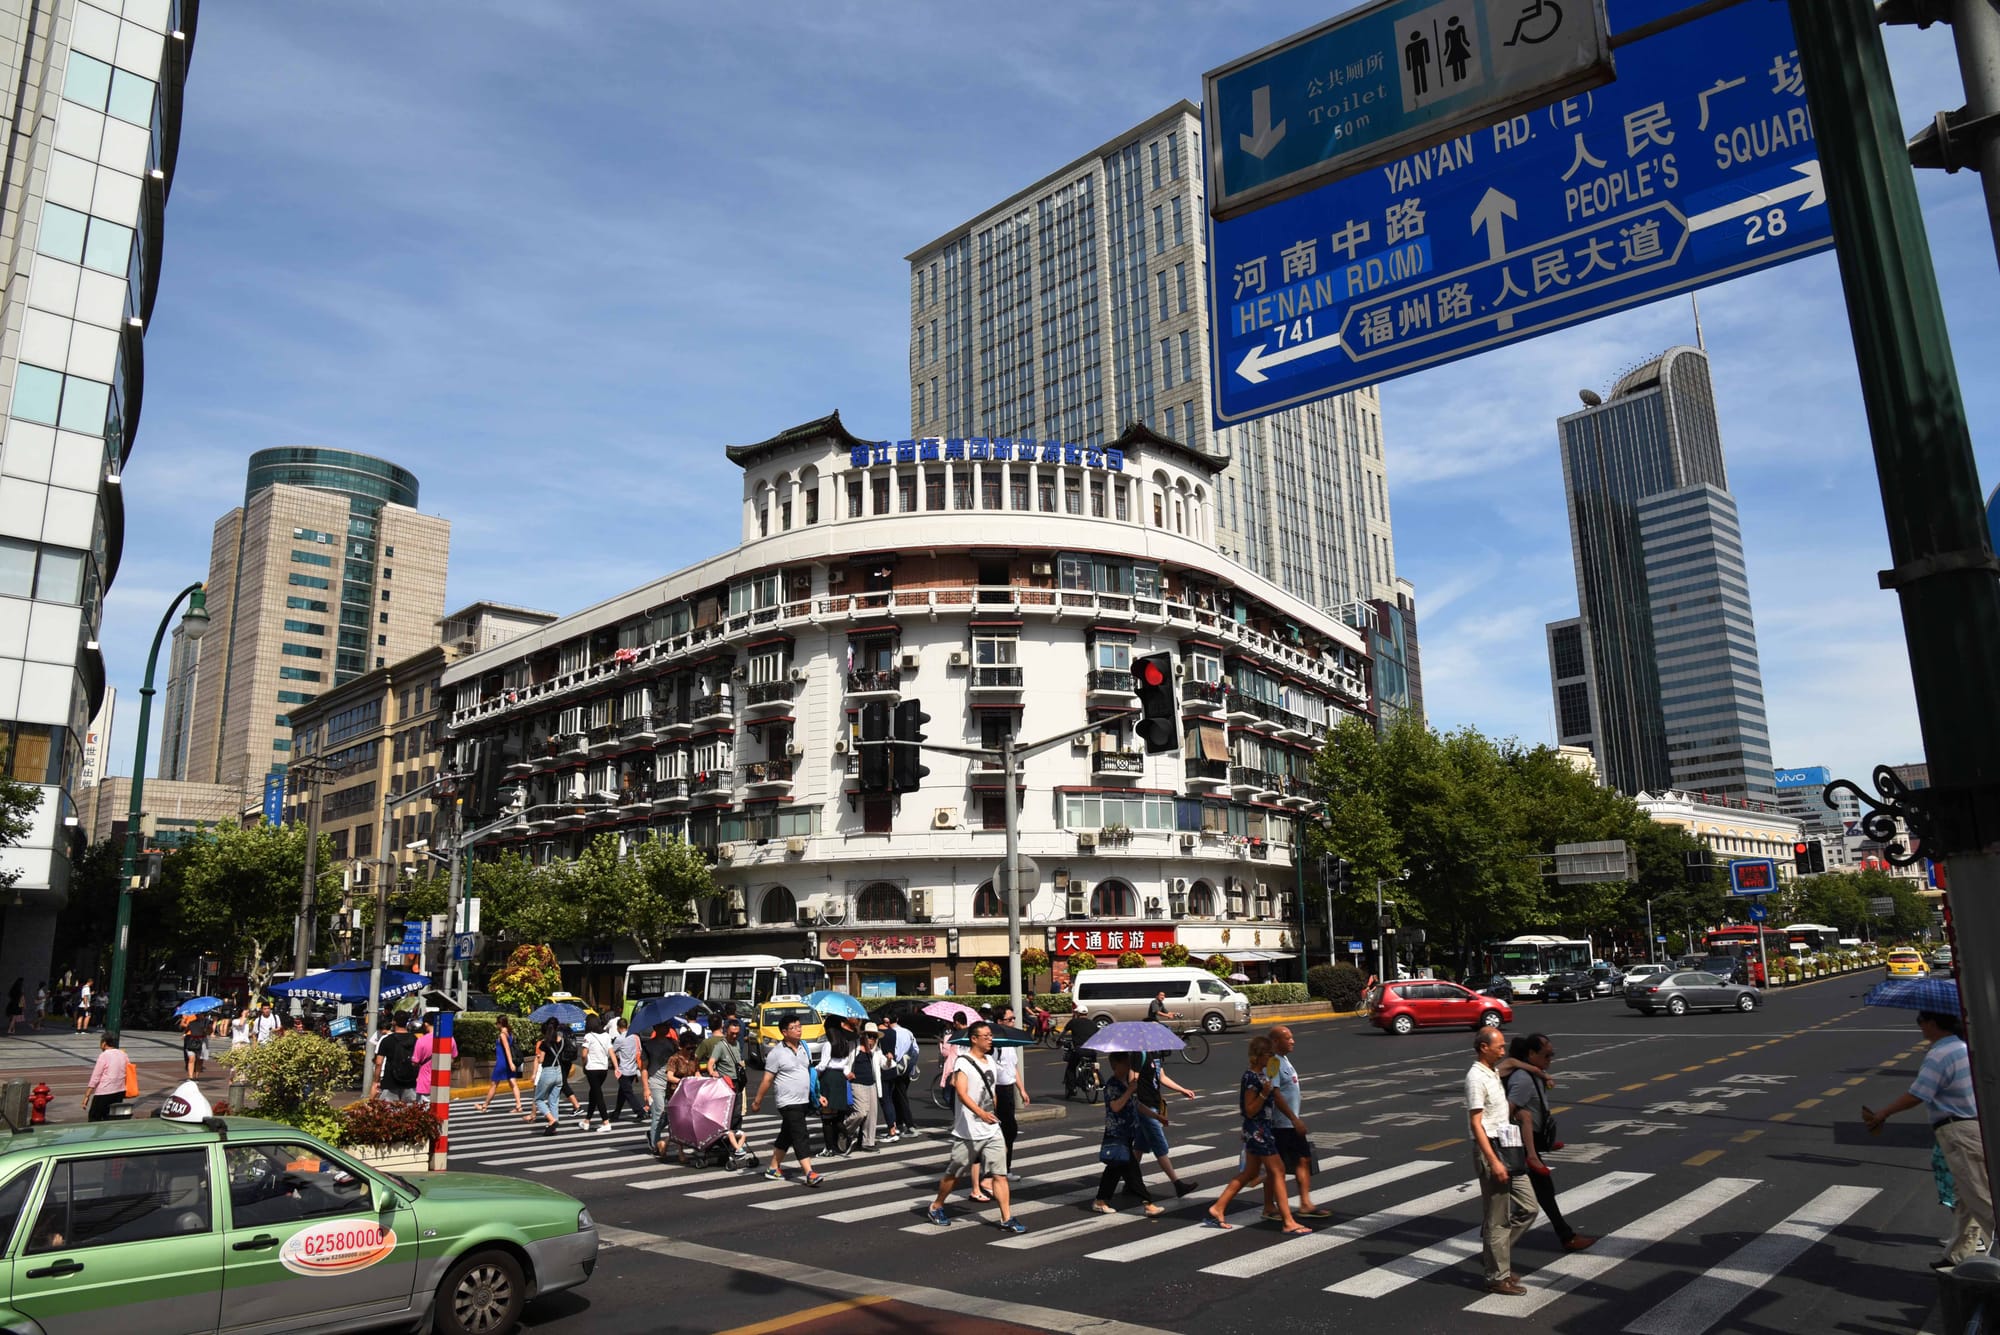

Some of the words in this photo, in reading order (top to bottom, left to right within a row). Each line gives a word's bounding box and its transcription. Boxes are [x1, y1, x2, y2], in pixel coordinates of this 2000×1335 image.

[1307, 50, 1385, 98] 公共厕所
[1308, 83, 1388, 125] Toilet
[1384, 133, 1474, 194] YAN'AN
[1492, 113, 1537, 153] RD.
[1549, 90, 1593, 130] (E)
[1565, 152, 1679, 222] PEOPLE'S
[1743, 207, 1788, 245] 28
[1233, 197, 1427, 301] 河南中路
[1240, 274, 1333, 335] HE'NAN
[1273, 315, 1314, 349] 741
[1775, 773, 1806, 783] vivo
[1063, 931, 1146, 951] 大通旅游
[171, 1101, 188, 1115] TAXI
[304, 1228, 385, 1256] 62580000
